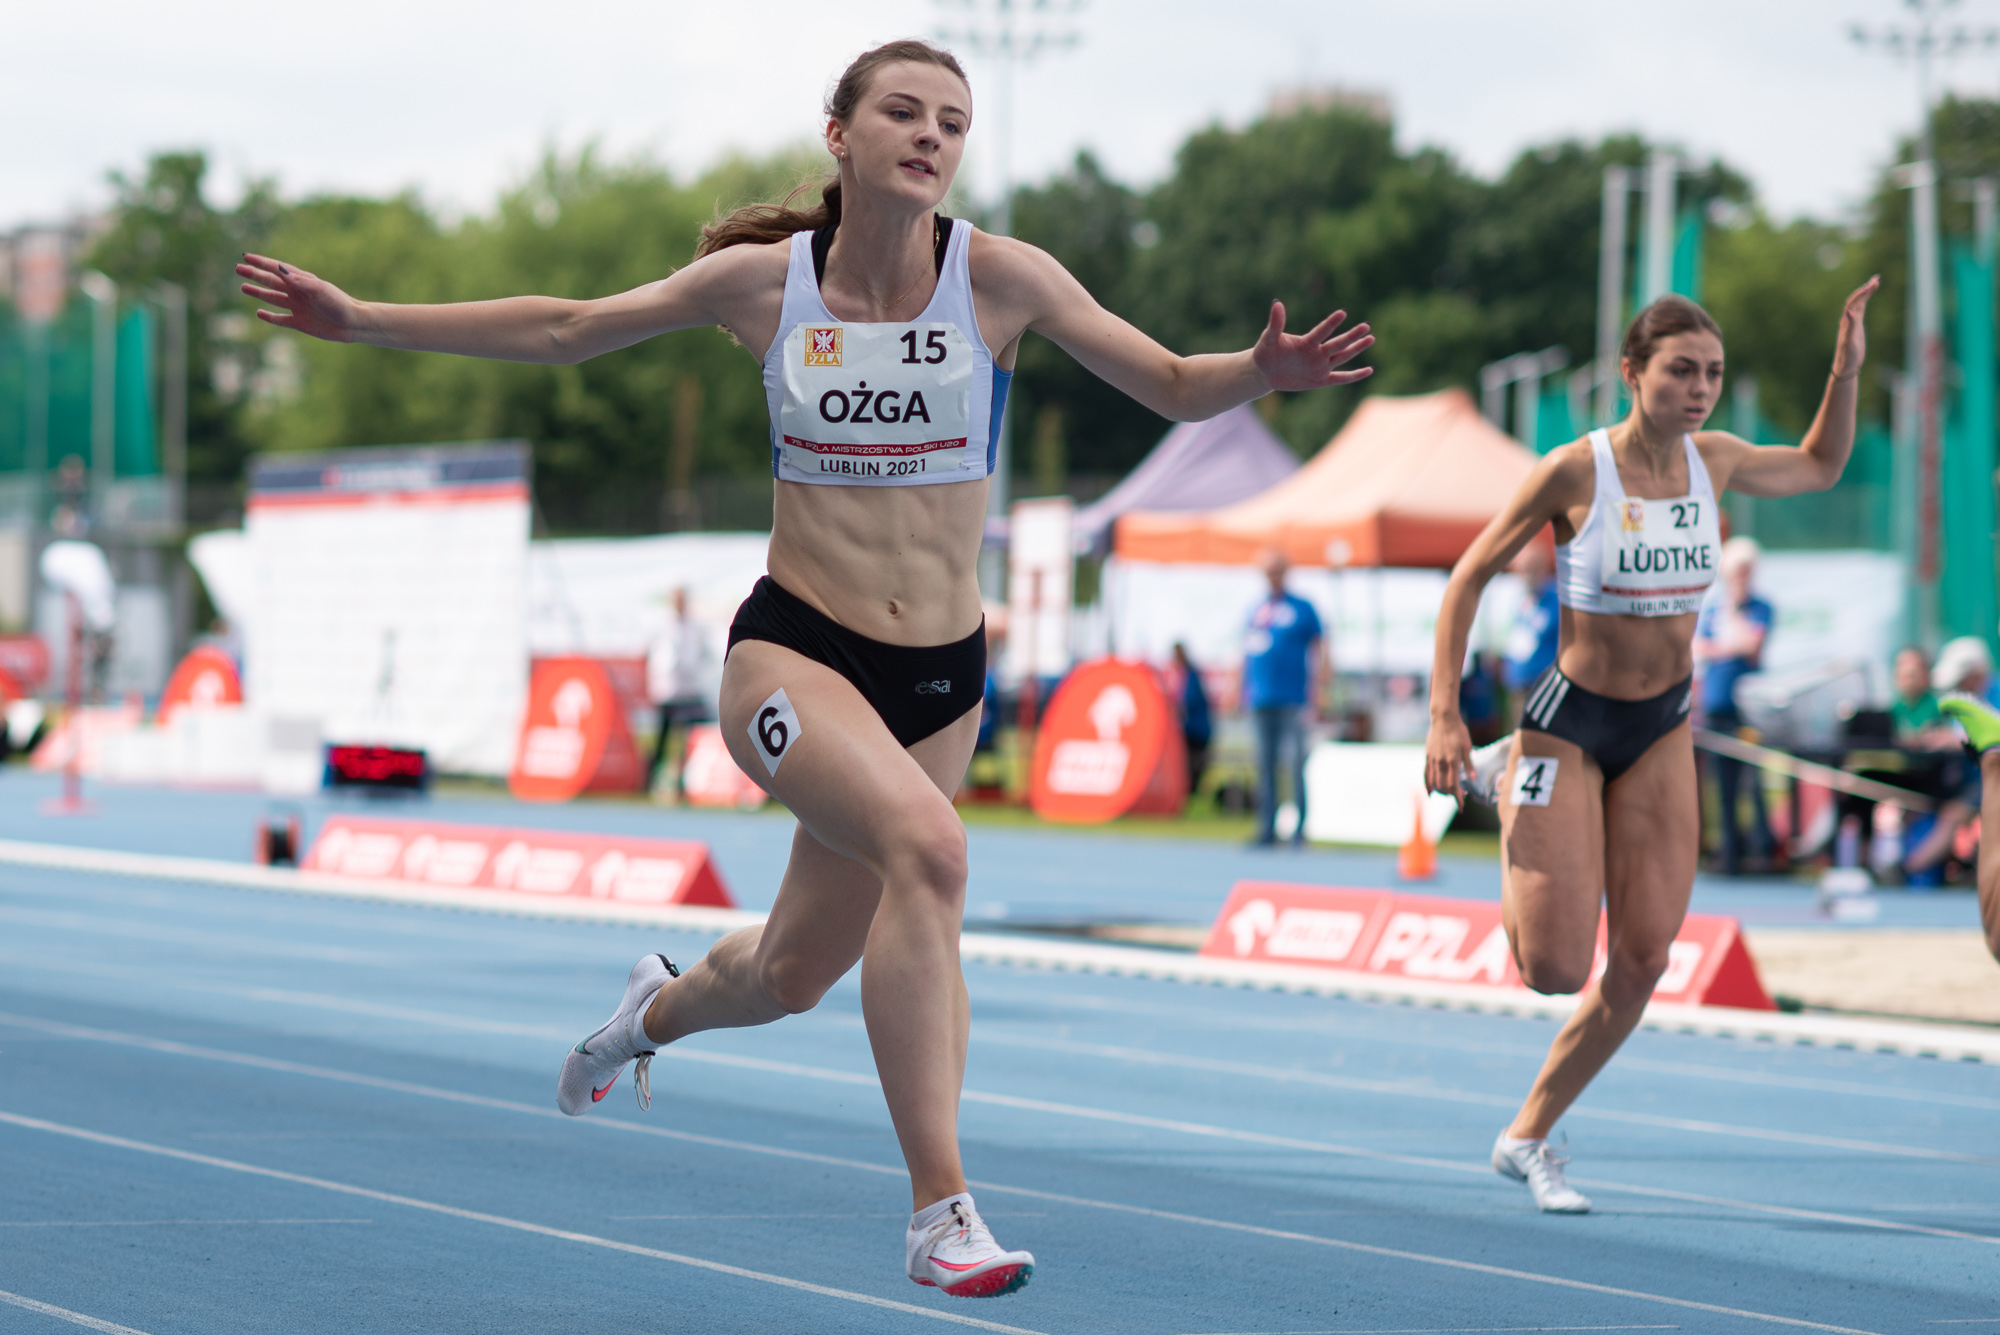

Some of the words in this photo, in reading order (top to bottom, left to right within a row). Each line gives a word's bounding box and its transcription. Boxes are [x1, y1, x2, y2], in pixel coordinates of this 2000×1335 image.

[806, 353, 840, 365] PZLA
[900, 330, 947, 364] 15
[819, 381, 931, 423] OŻGA
[806, 442, 830, 453] PZLA
[831, 445, 904, 455] MISTRZOSTWA
[905, 442, 938, 454] POLSKI
[940, 440, 960, 448] U20
[820, 459, 880, 476] LUBLIN
[886, 458, 926, 476] 2021
[1670, 503, 1700, 529] 27
[1619, 542, 1712, 573] LÜDTKE
[1631, 600, 1669, 613] LUBLIN
[758, 706, 788, 757] 6
[1521, 763, 1546, 800] 4
[1370, 911, 1511, 984] PZLA
